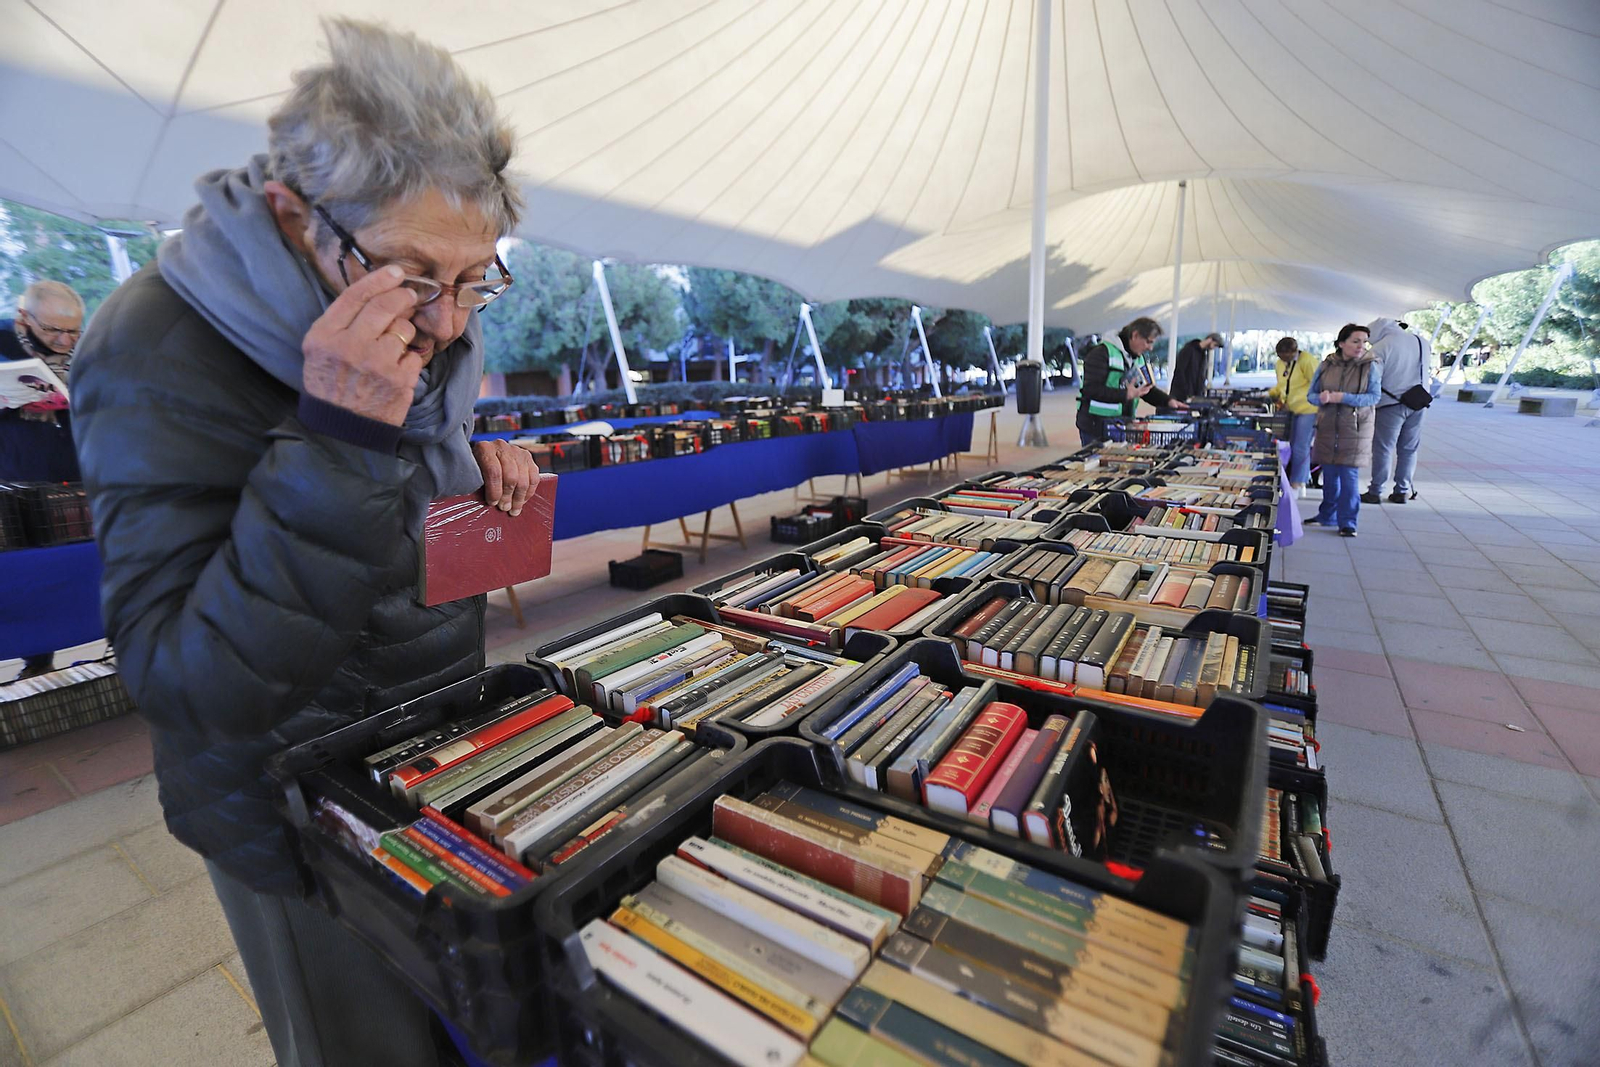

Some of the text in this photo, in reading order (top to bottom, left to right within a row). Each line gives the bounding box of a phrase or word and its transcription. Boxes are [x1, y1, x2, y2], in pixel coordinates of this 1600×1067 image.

[609, 734, 649, 764] MUNDO
[583, 767, 601, 782] DE
[598, 760, 611, 772] ES
[541, 776, 586, 809] CRISTAL
